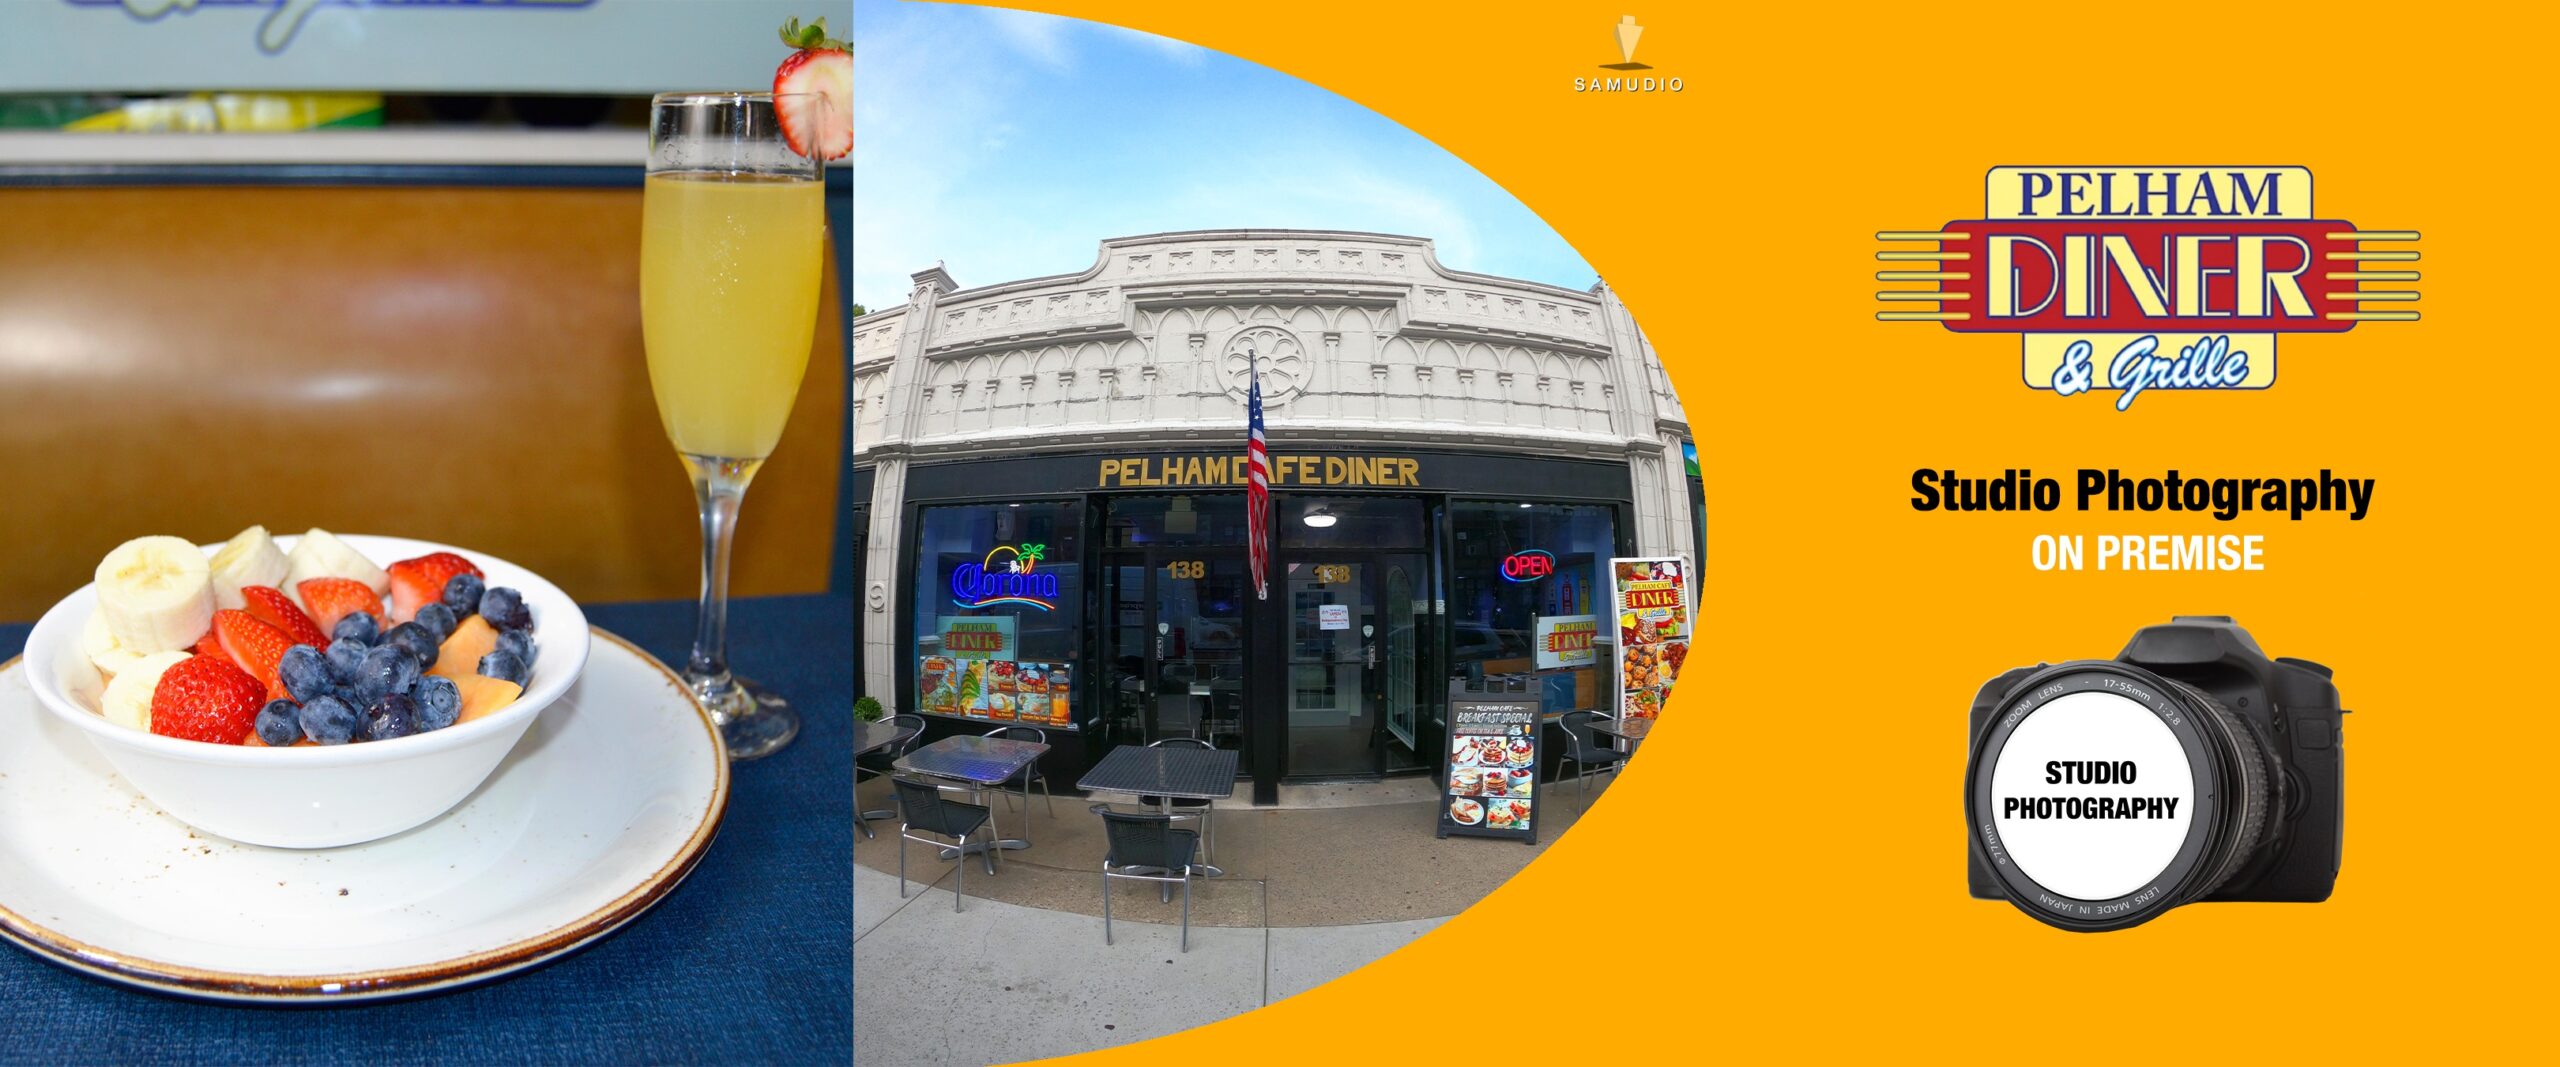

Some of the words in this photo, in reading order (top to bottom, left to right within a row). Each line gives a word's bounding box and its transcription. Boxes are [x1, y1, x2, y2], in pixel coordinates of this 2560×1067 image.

[1099, 456, 1227, 486] PELHAM
[1326, 457, 1420, 486] DINER
[1167, 560, 1205, 579] 138
[1505, 555, 1552, 576] OPEN
[952, 562, 1058, 602] Corona
[1631, 592, 1673, 606] DINER
[1457, 712, 1502, 723] BREAKFAST
[1502, 713, 1533, 723] SPECIAL
